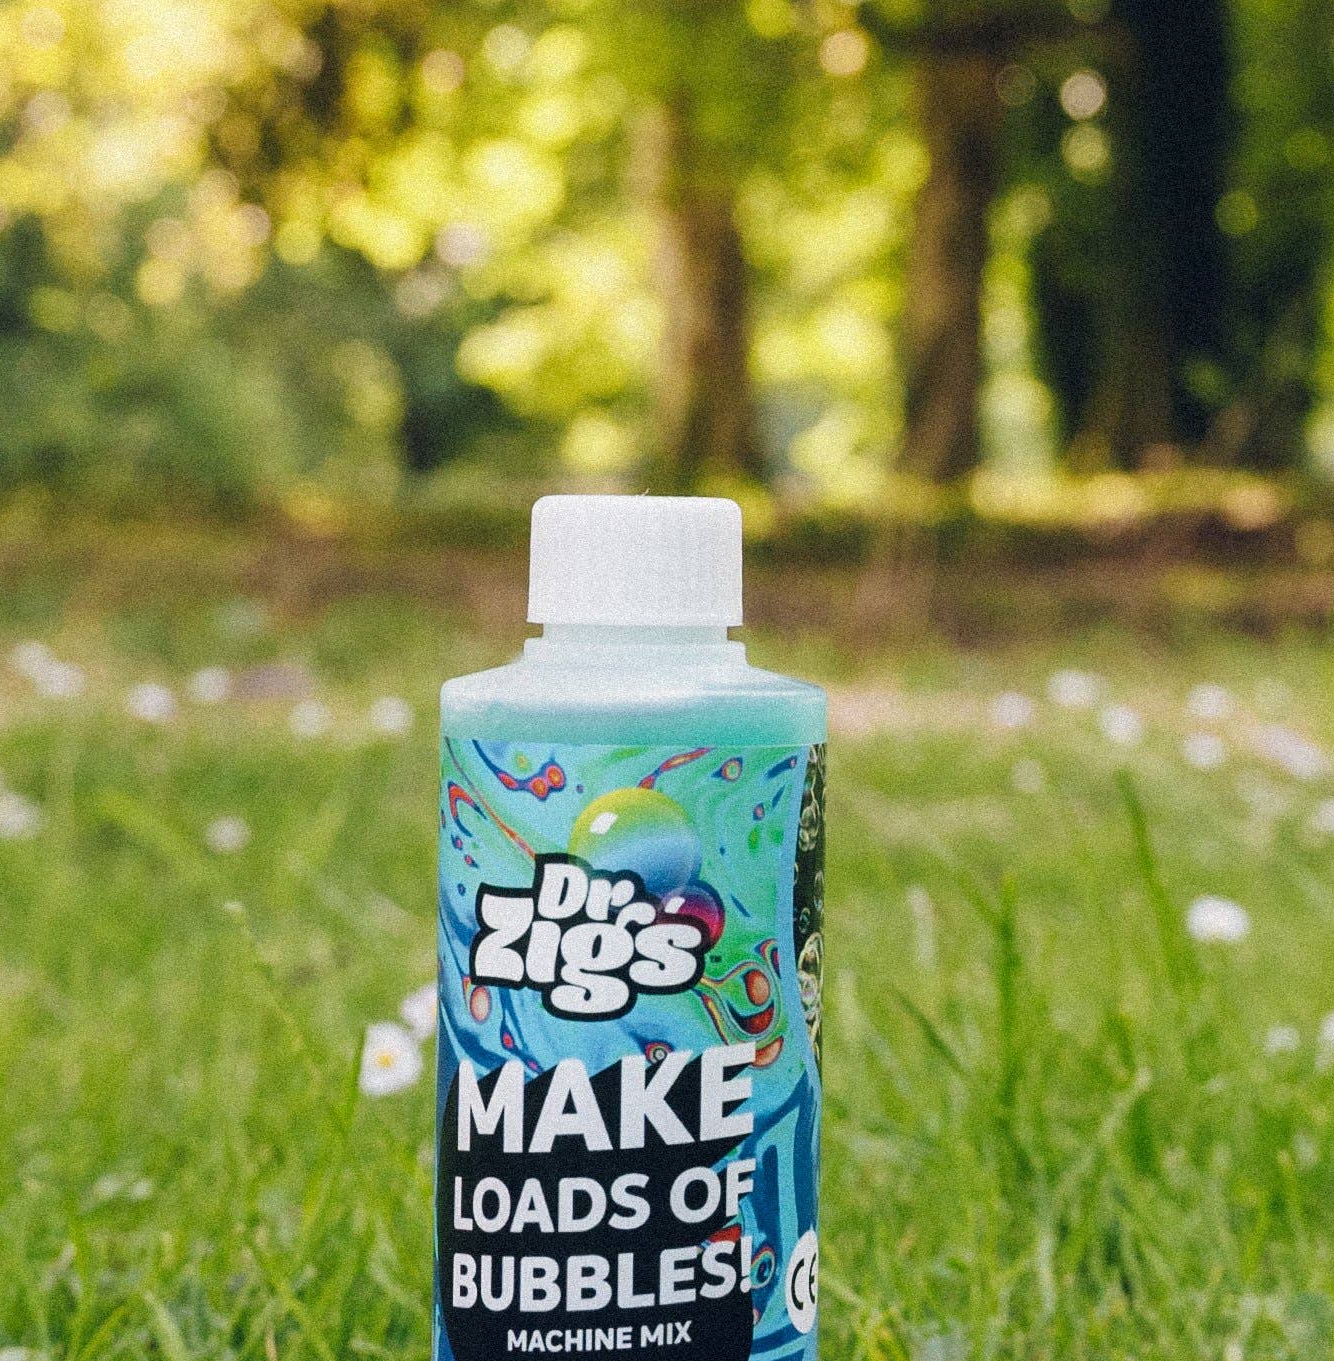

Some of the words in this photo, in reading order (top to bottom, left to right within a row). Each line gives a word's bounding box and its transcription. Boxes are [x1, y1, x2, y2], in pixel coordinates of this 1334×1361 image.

[537, 862, 635, 921] Dr
[456, 1041, 756, 1154] MAKE
[453, 1173, 651, 1234] LOADS
[669, 1158, 756, 1224] OF
[452, 1235, 753, 1313] BUBBLES!
[506, 1325, 633, 1353] MACHINE
[640, 1320, 692, 1348] MIX
